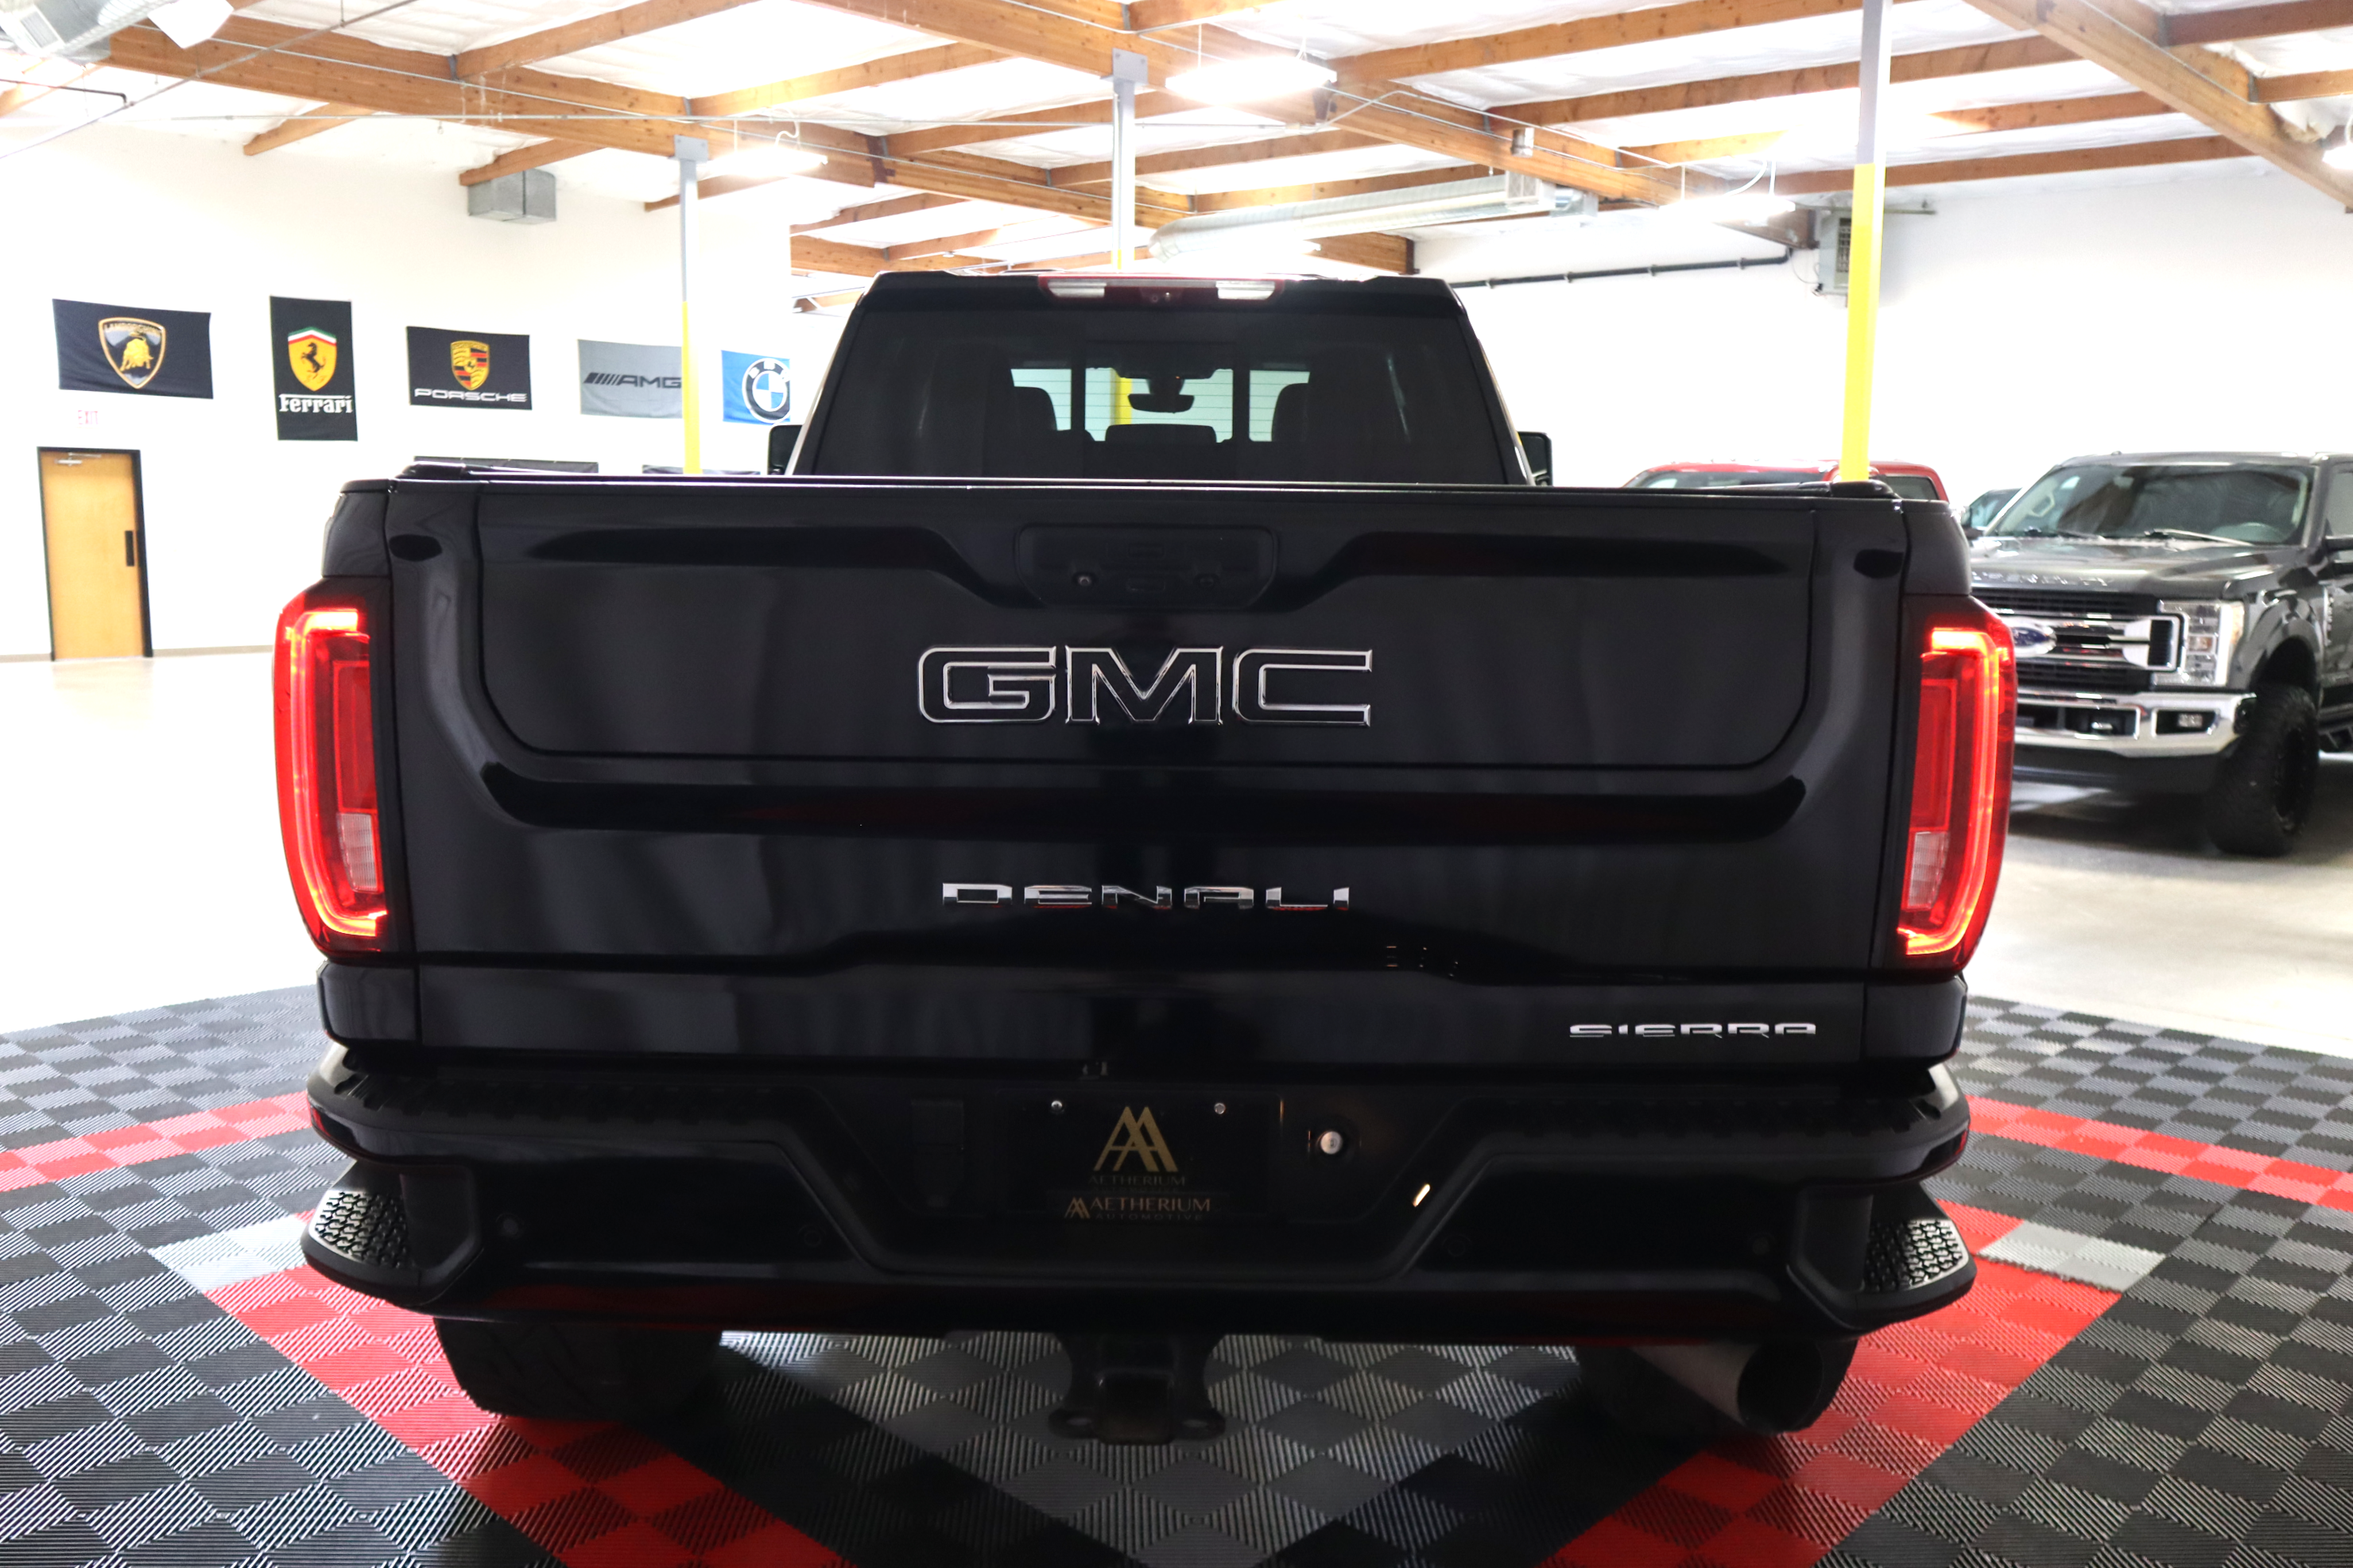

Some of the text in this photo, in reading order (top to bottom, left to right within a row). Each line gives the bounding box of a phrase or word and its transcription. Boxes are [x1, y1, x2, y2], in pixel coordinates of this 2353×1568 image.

[278, 393, 353, 413] Ferrari
[414, 388, 527, 402] PORSCHE
[77, 409, 99, 425] EXIT
[917, 645, 1373, 727] GMC
[942, 883, 1350, 912] DENALI
[1568, 1022, 1816, 1039] SIERRA
[1087, 1175, 1186, 1187] AETHERIUM
[1090, 1197, 1211, 1212] AETHERIUM
